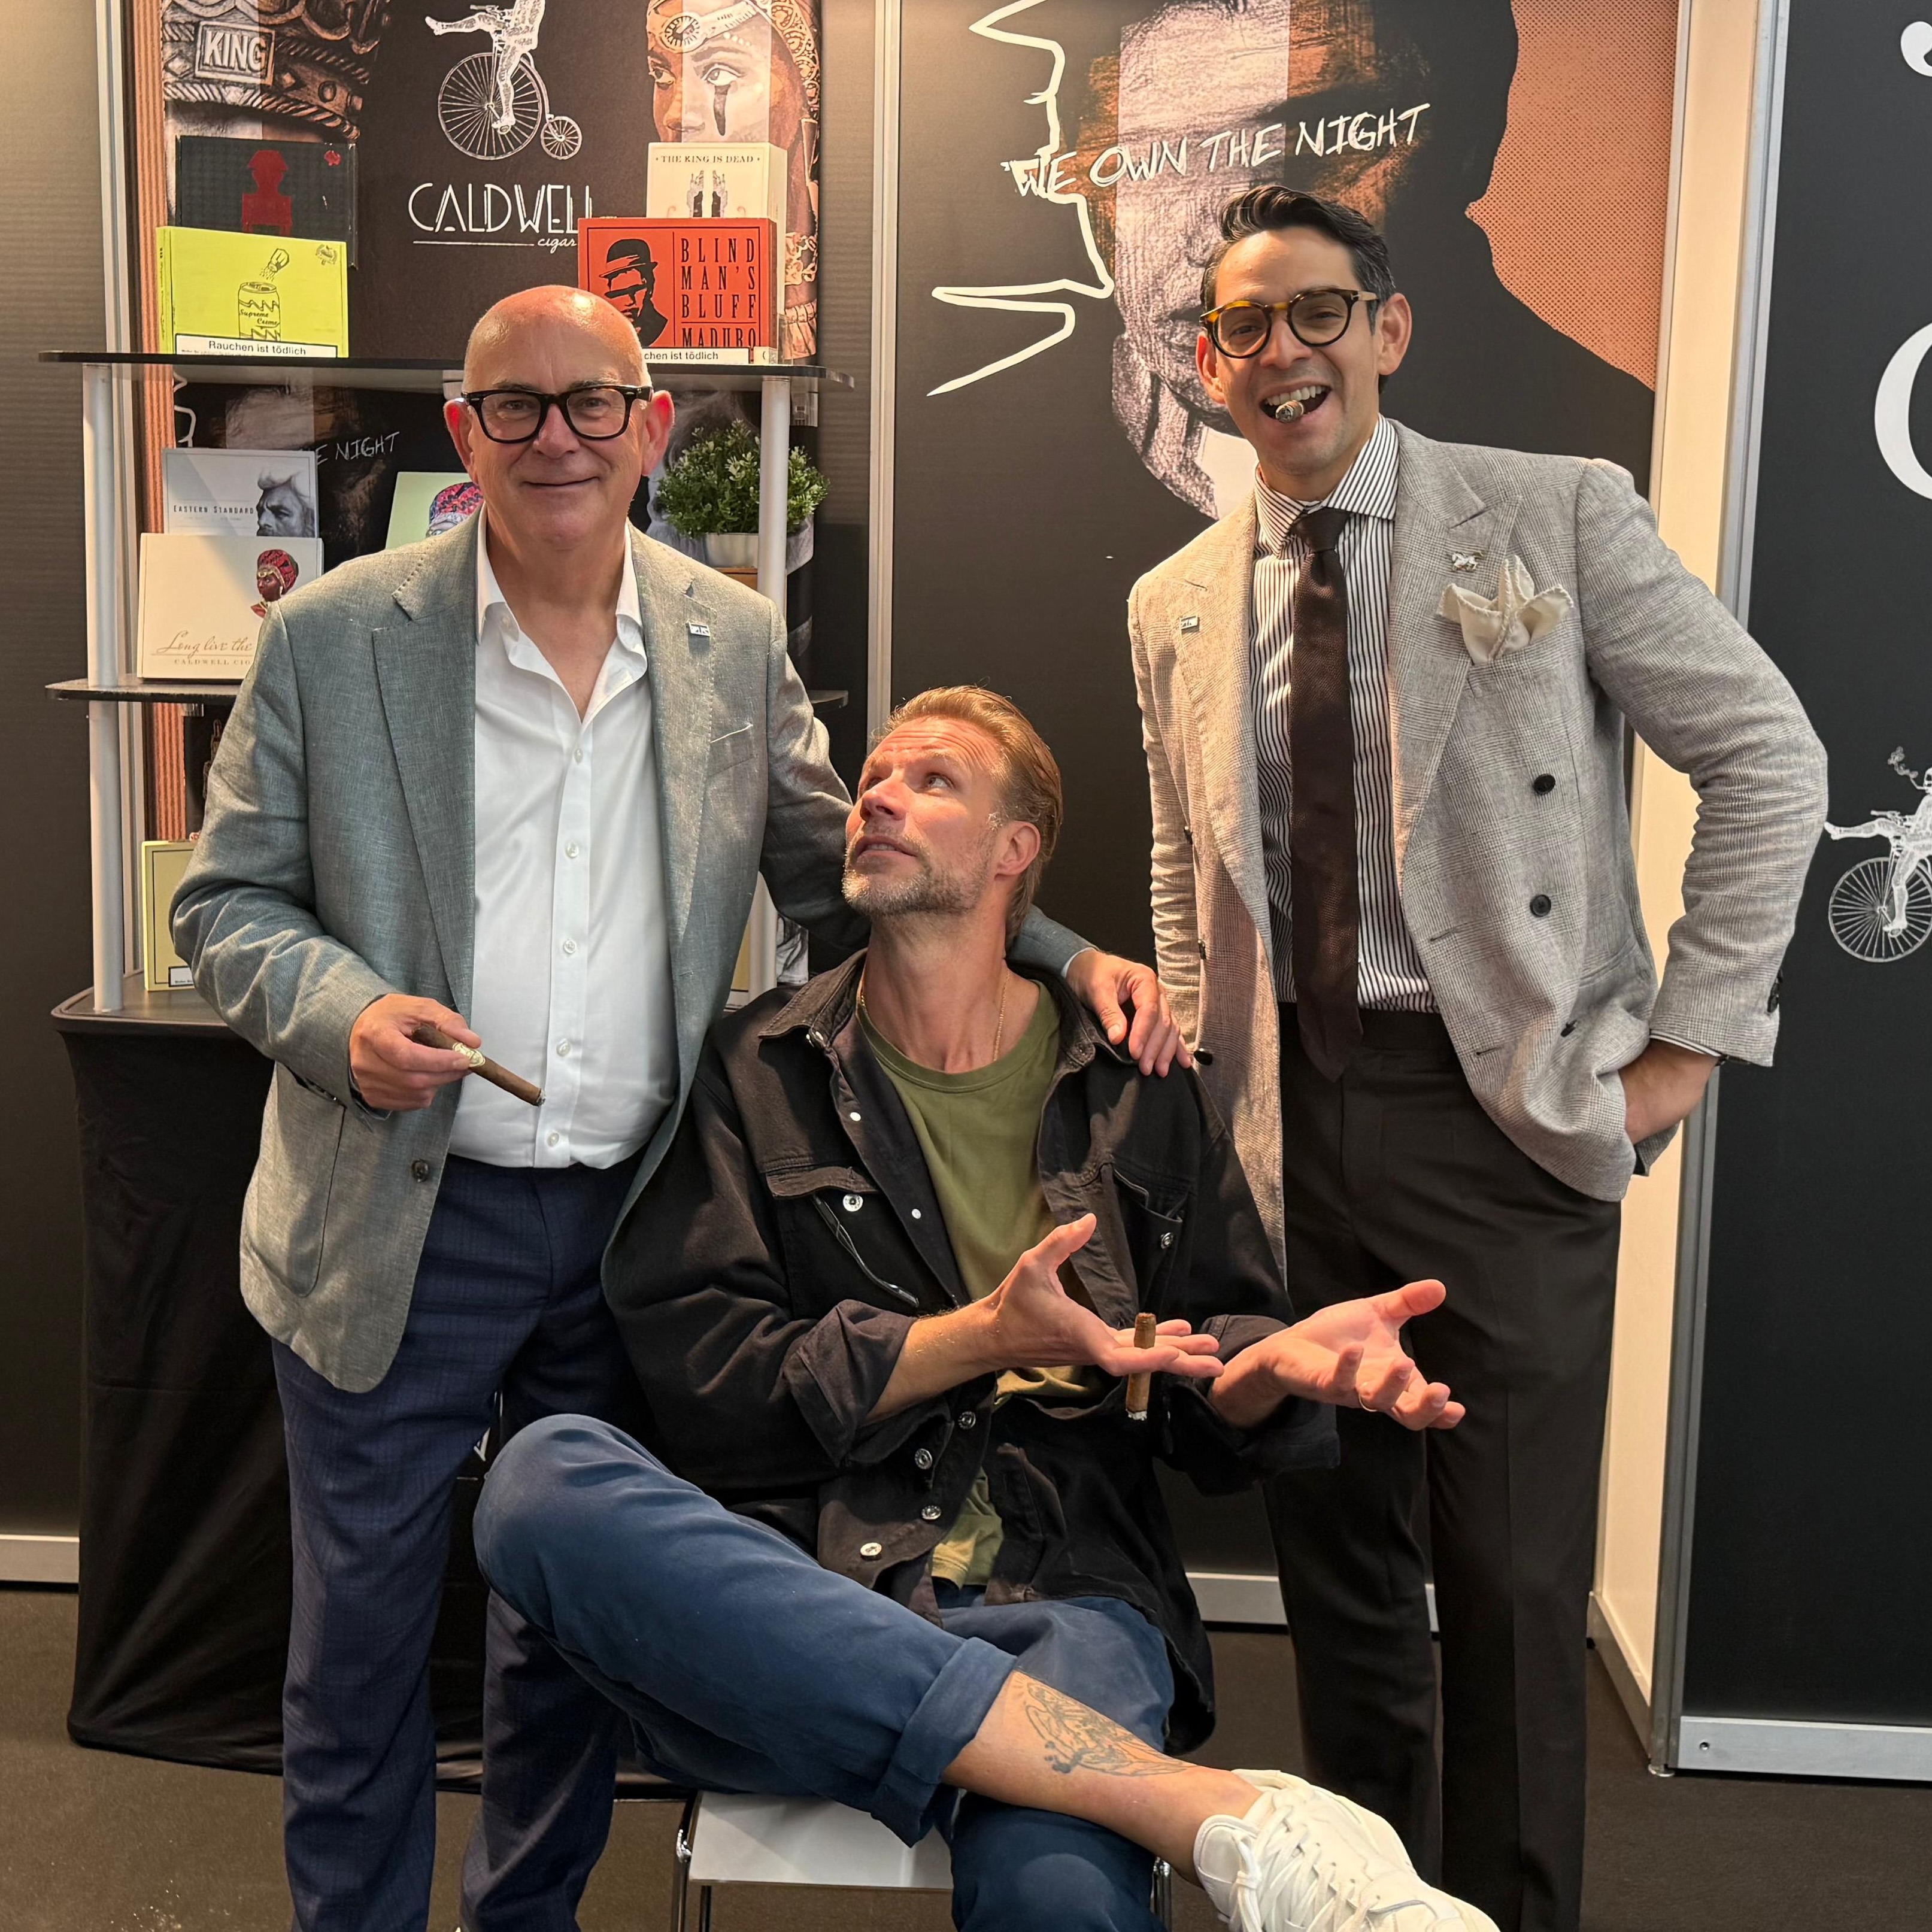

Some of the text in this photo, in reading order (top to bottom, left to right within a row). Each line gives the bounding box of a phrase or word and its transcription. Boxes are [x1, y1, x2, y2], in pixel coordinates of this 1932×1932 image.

[202, 30, 266, 72] KING
[1090, 137, 1188, 187] OWN
[1200, 123, 1282, 172] THE
[1296, 103, 1431, 156] NIGHT
[681, 238, 754, 262] BLIND
[681, 266, 756, 290] MAN'S
[681, 294, 756, 318] BLUFF
[209, 340, 254, 353] Rauchen
[257, 344, 269, 353] ist
[272, 347, 306, 355] tödlich
[686, 351, 718, 360] tödlich
[335, 431, 400, 460] NIGHT
[174, 505, 208, 513] EASTERN
[156, 630, 201, 659] Long
[231, 637, 253, 651] the
